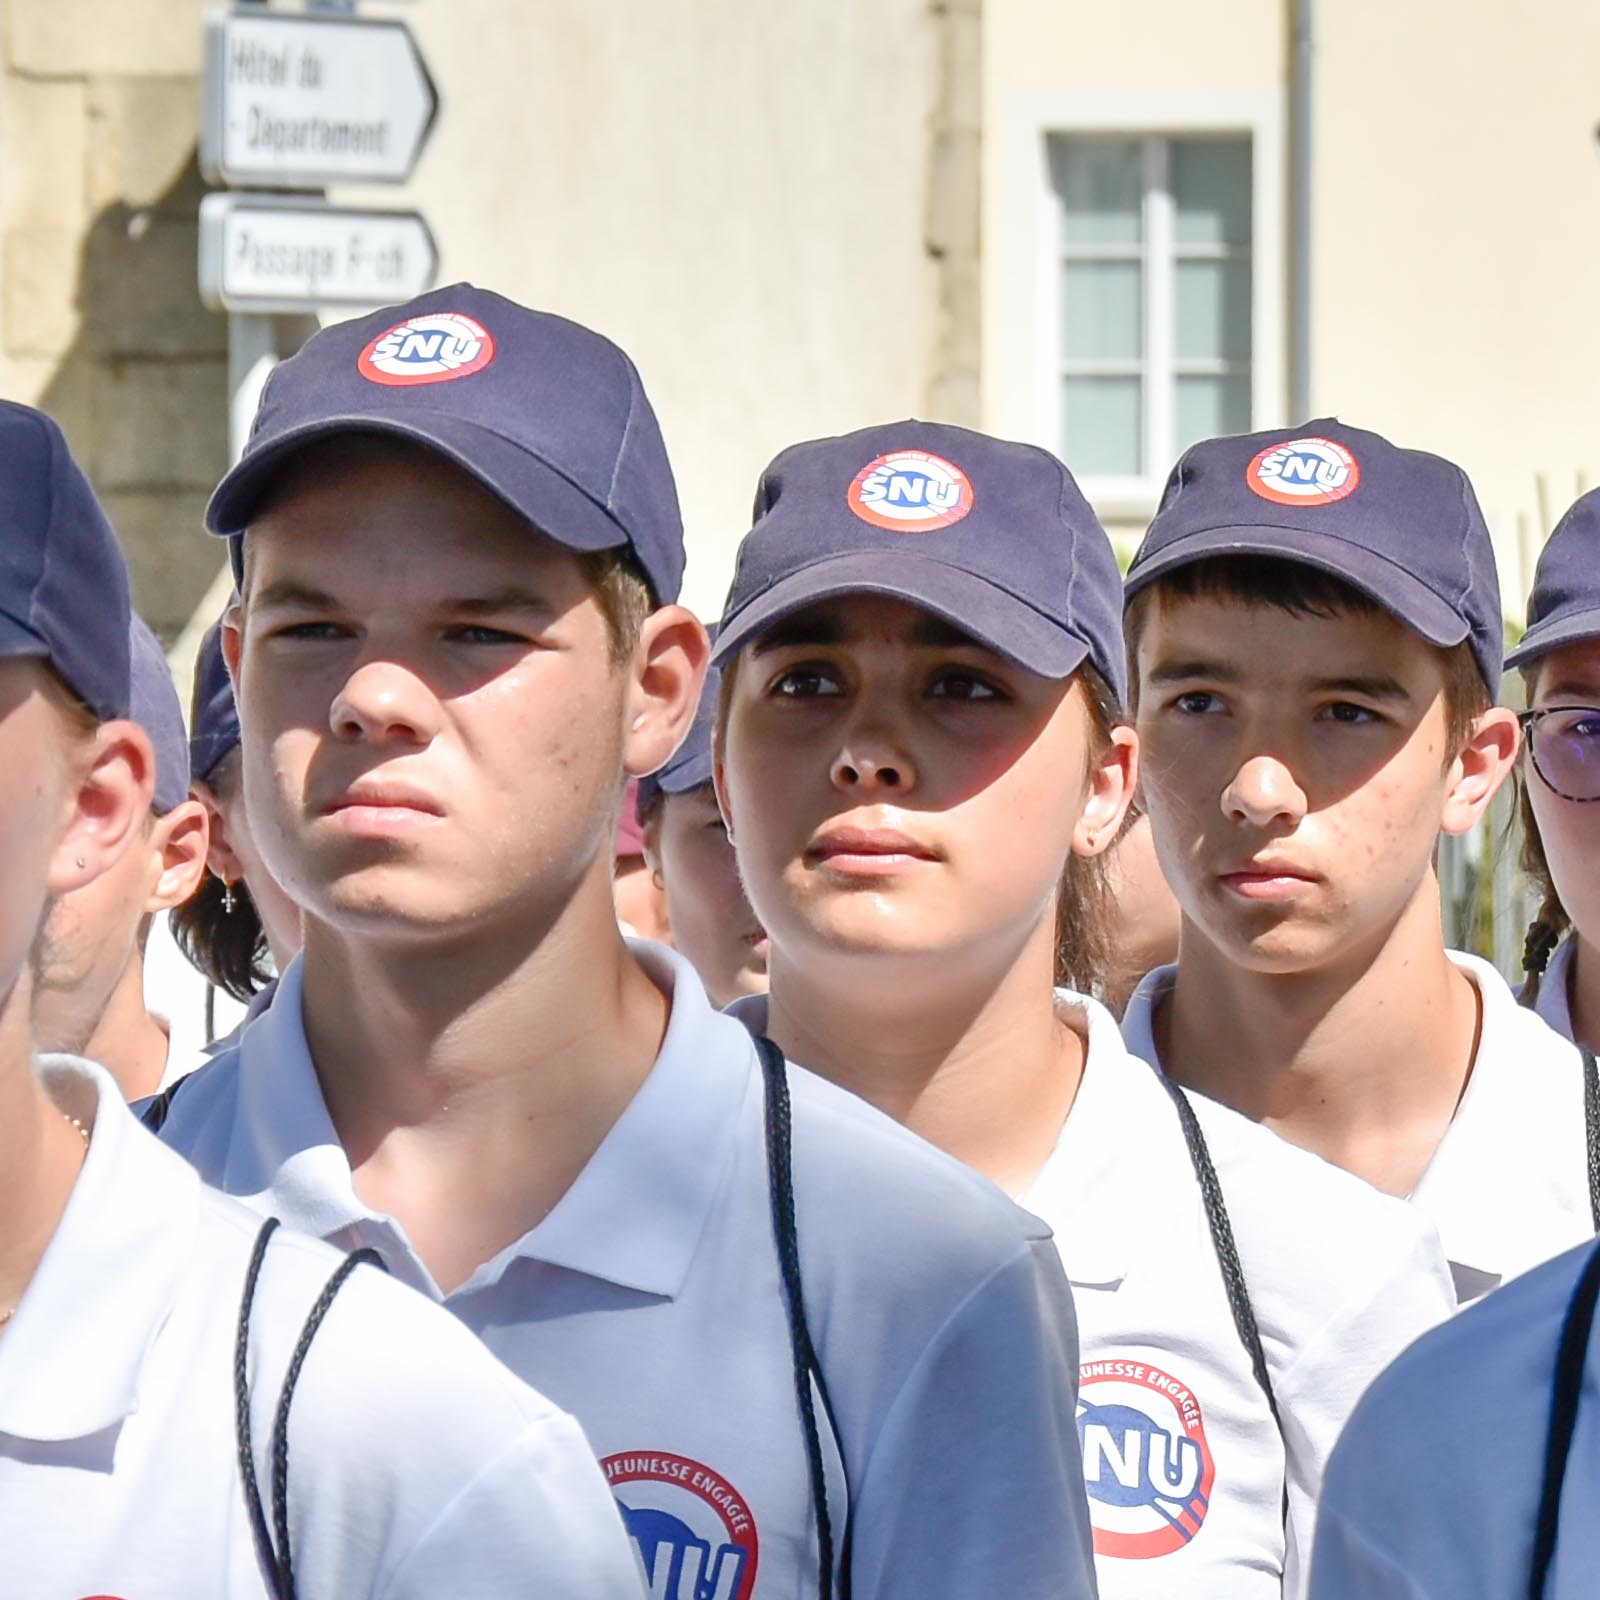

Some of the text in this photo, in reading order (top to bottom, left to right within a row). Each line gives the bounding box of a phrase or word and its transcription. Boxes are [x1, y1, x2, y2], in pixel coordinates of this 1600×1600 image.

[368, 334, 482, 364] SNU
[859, 475, 961, 509] SNU
[1256, 454, 1351, 489] SNU
[1079, 1362, 1200, 1430] UNESSE ENGAGÉE
[1083, 1424, 1200, 1499] NU
[606, 1458, 749, 1534] JEUNESSE ENGAGÉE
